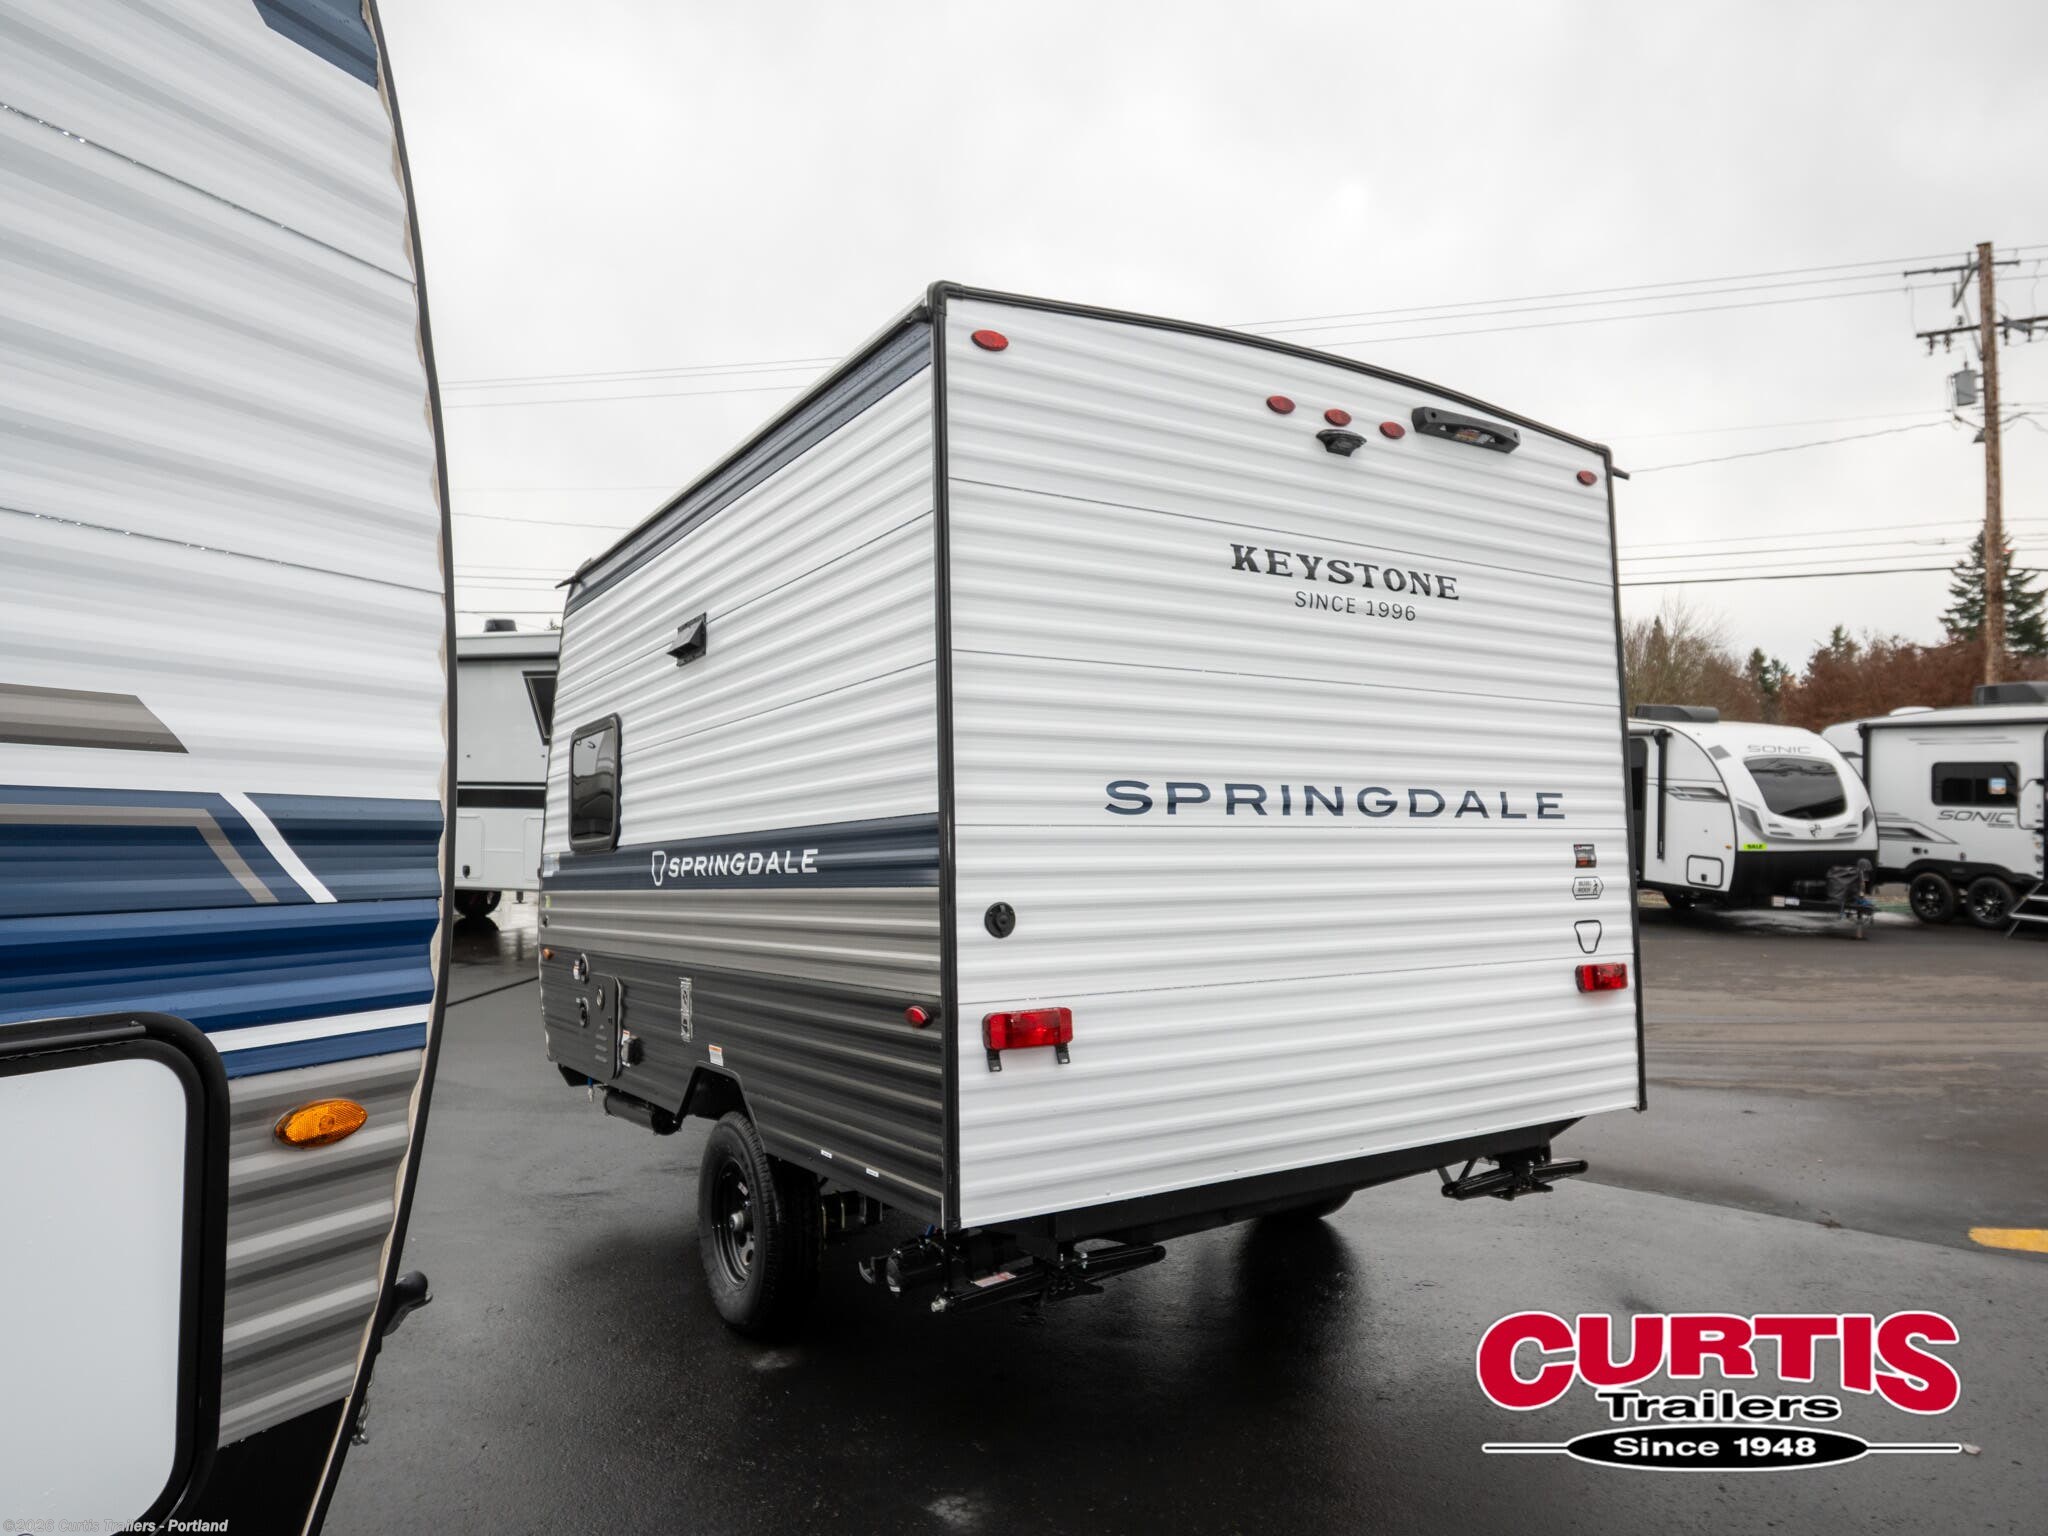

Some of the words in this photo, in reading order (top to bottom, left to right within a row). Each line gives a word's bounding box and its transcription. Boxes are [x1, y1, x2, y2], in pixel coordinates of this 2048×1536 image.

[1230, 543, 1459, 601] KEYSTONE
[1294, 590, 1357, 615] SINCE
[1365, 599, 1416, 622] 1996
[1747, 744, 1812, 755] SONIC
[1105, 779, 1566, 820] SPRINGDALE
[1937, 810, 2017, 824] SONIC
[667, 848, 819, 878] SPRINGDALE
